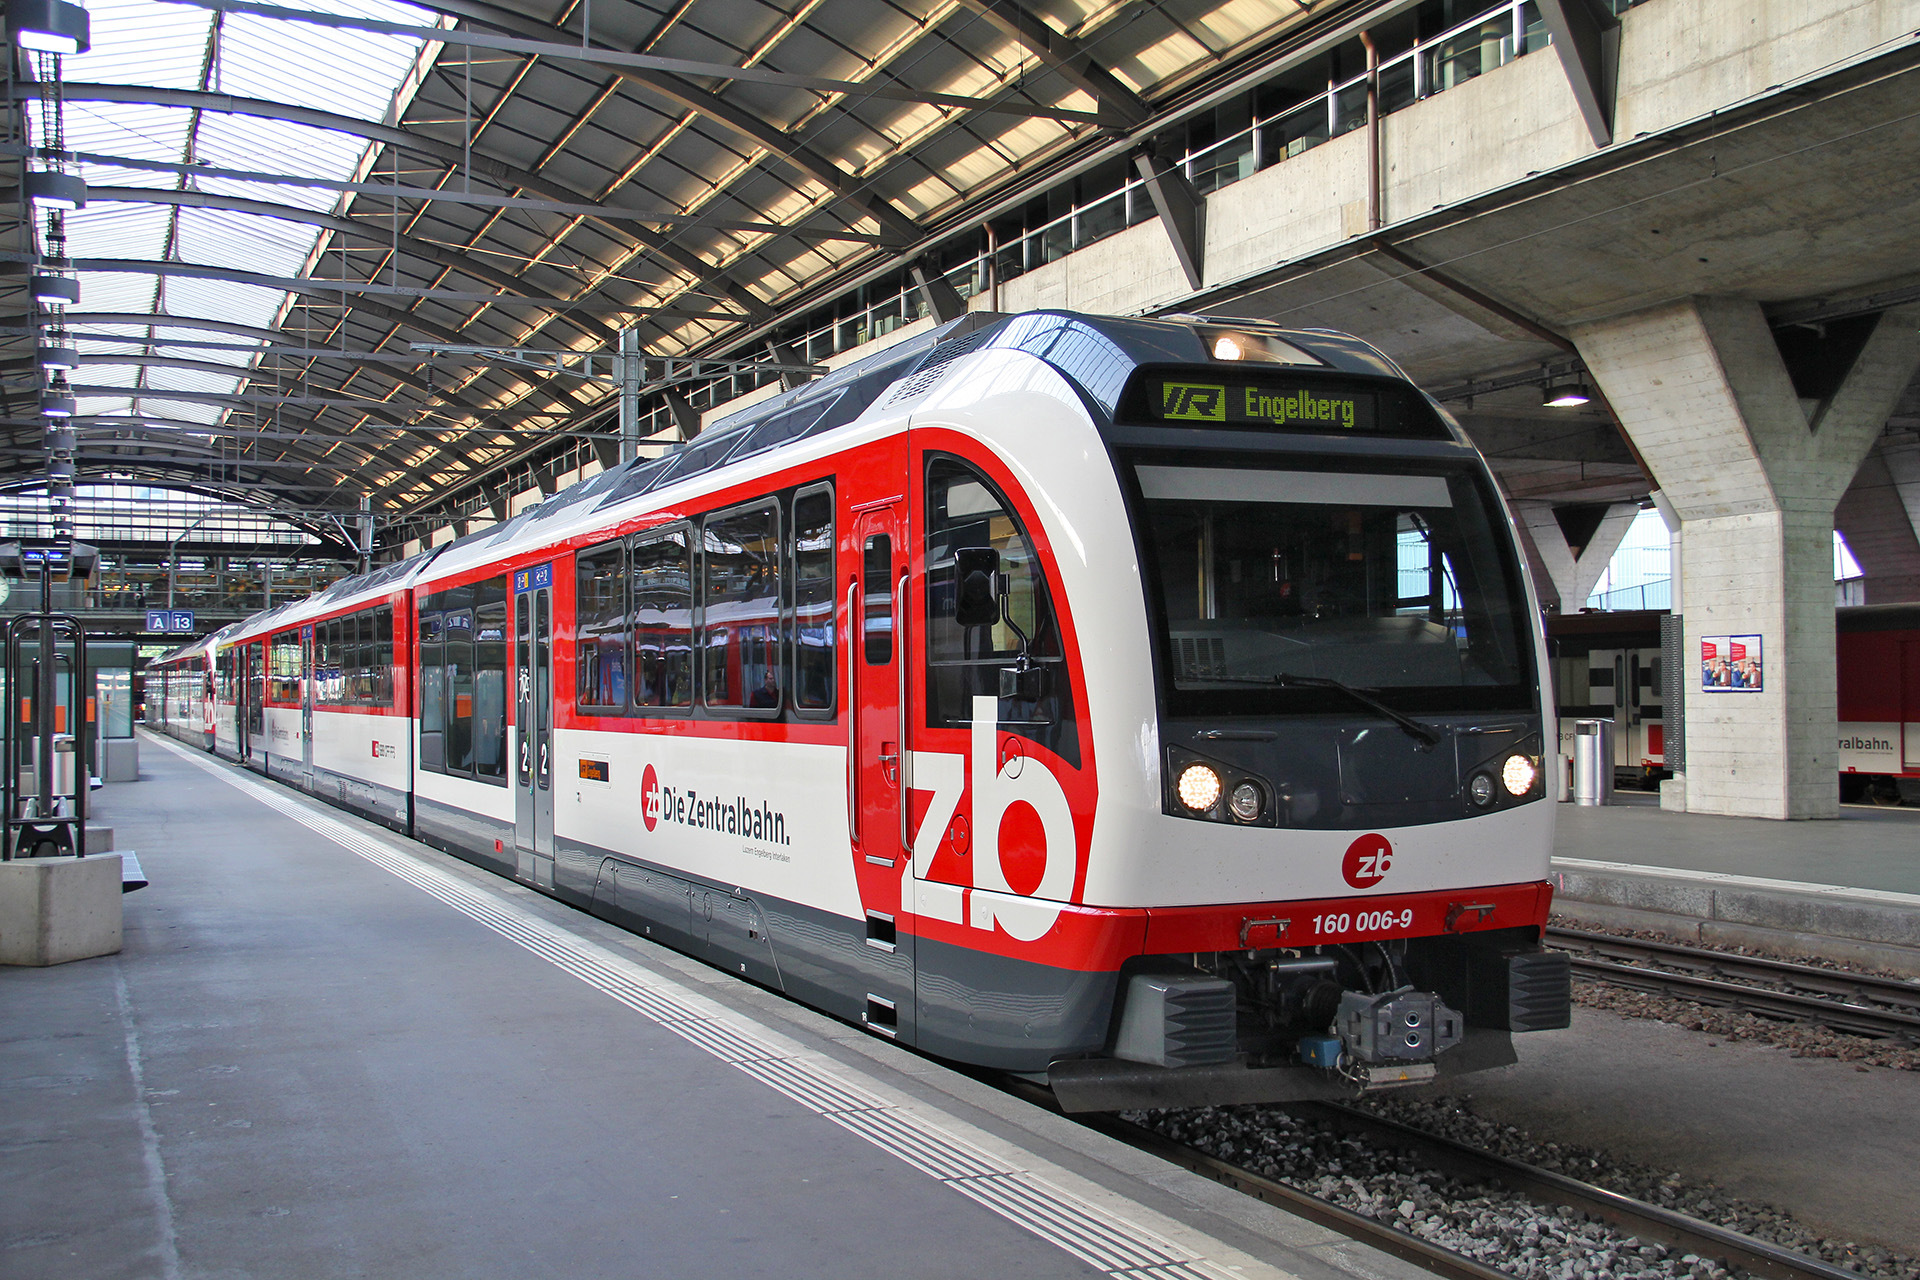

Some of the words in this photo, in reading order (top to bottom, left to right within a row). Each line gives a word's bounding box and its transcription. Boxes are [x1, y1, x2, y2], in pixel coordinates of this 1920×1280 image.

[1164, 385, 1222, 418] IR
[1245, 386, 1354, 428] Engelberg
[153, 618, 164, 628] A
[174, 618, 190, 628] 13
[522, 741, 528, 771] 2
[1838, 736, 1893, 750] ralbahn.
[541, 743, 547, 774] 2
[646, 783, 659, 818] zb
[663, 786, 685, 824] Die
[687, 790, 790, 845] Zentralbahn.
[901, 696, 1076, 942] zb
[1355, 848, 1393, 878] zb
[1313, 913, 1350, 934] 160
[1355, 908, 1413, 932] 006-9
